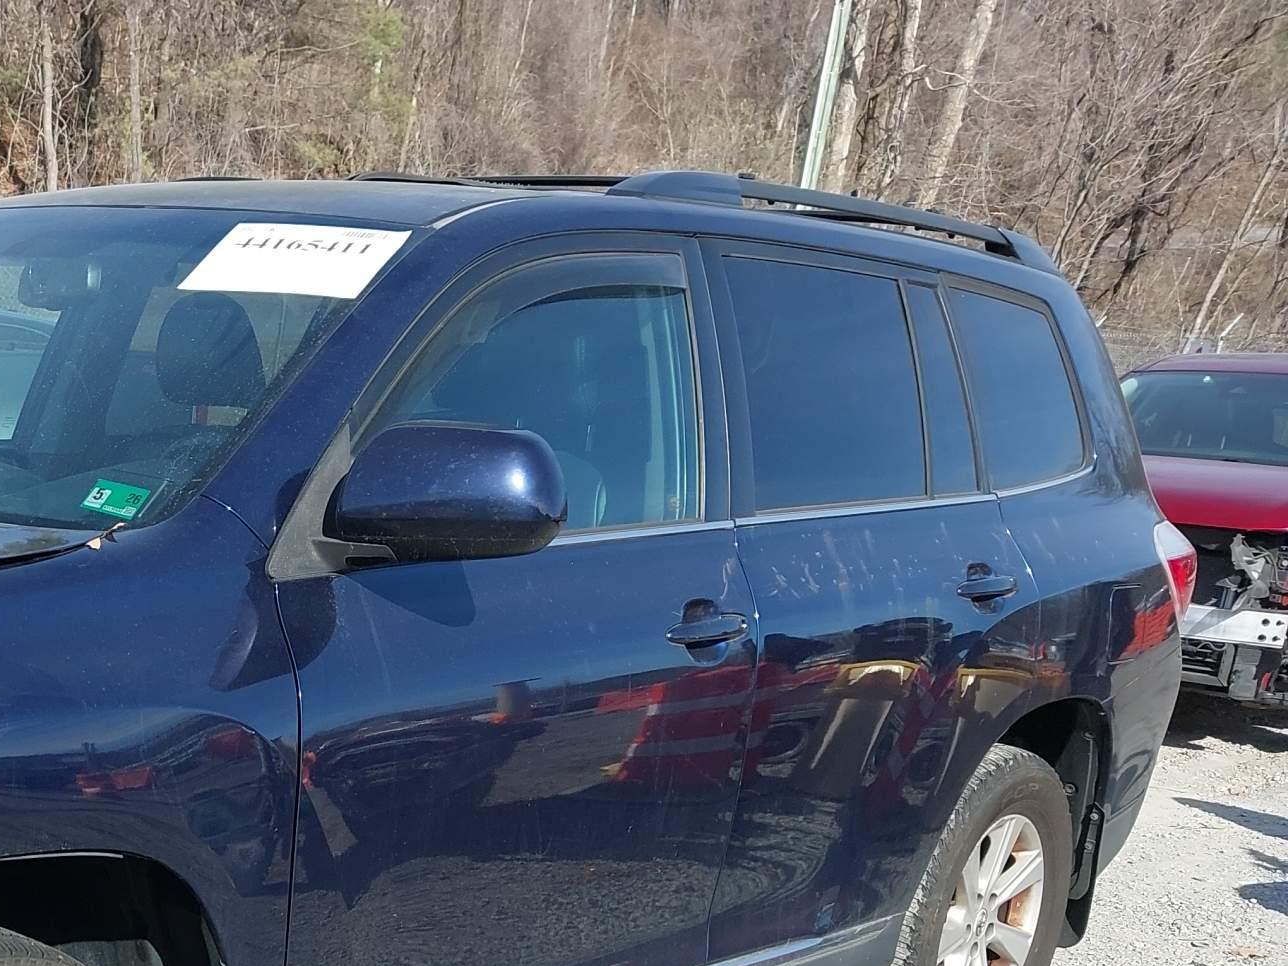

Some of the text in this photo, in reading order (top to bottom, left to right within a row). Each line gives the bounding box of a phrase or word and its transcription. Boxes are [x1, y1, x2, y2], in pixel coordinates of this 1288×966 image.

[234, 237, 372, 254] 44165411
[93, 487, 106, 500] 5
[125, 493, 143, 505] 26
